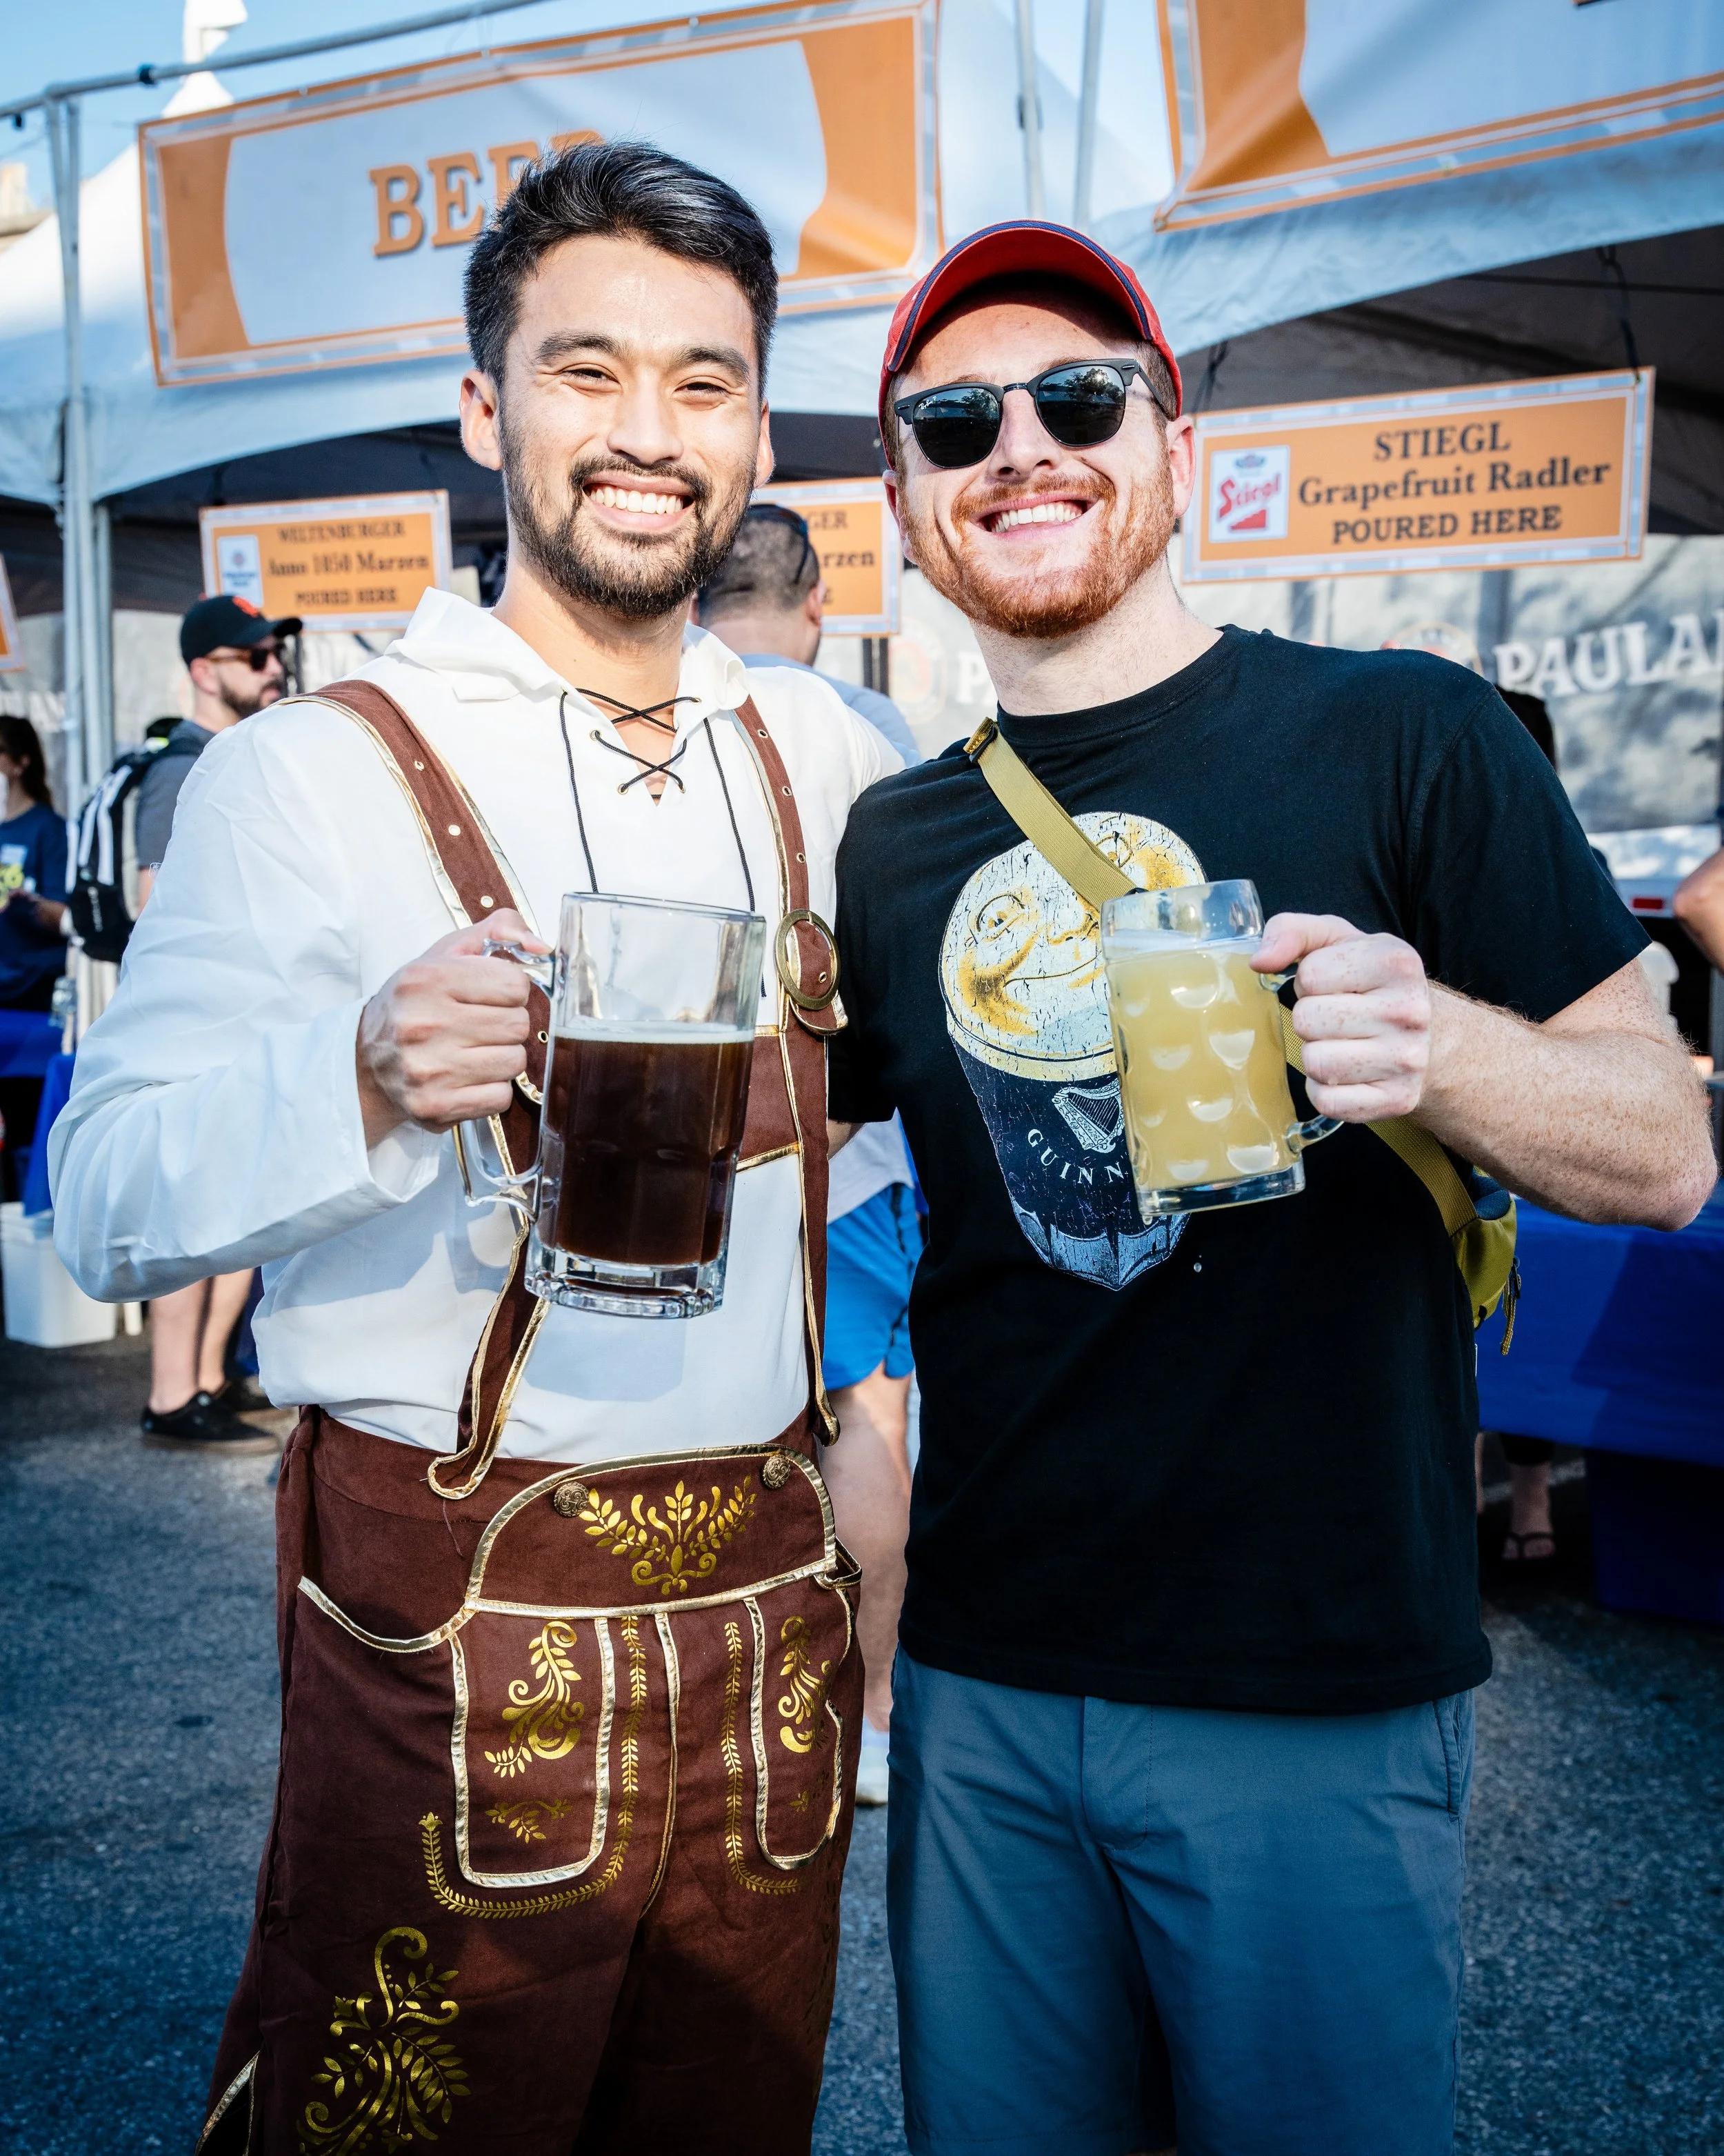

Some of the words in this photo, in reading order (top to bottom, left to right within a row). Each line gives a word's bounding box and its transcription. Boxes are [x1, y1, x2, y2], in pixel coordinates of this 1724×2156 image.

[1373, 421, 1510, 461] STIEGL
[1299, 465, 1475, 510] Grapefruit
[1488, 457, 1611, 492] Radler
[1332, 512, 1459, 545] POURED
[1470, 505, 1563, 535] HERE
[1028, 1128, 1125, 1185] GUINN
